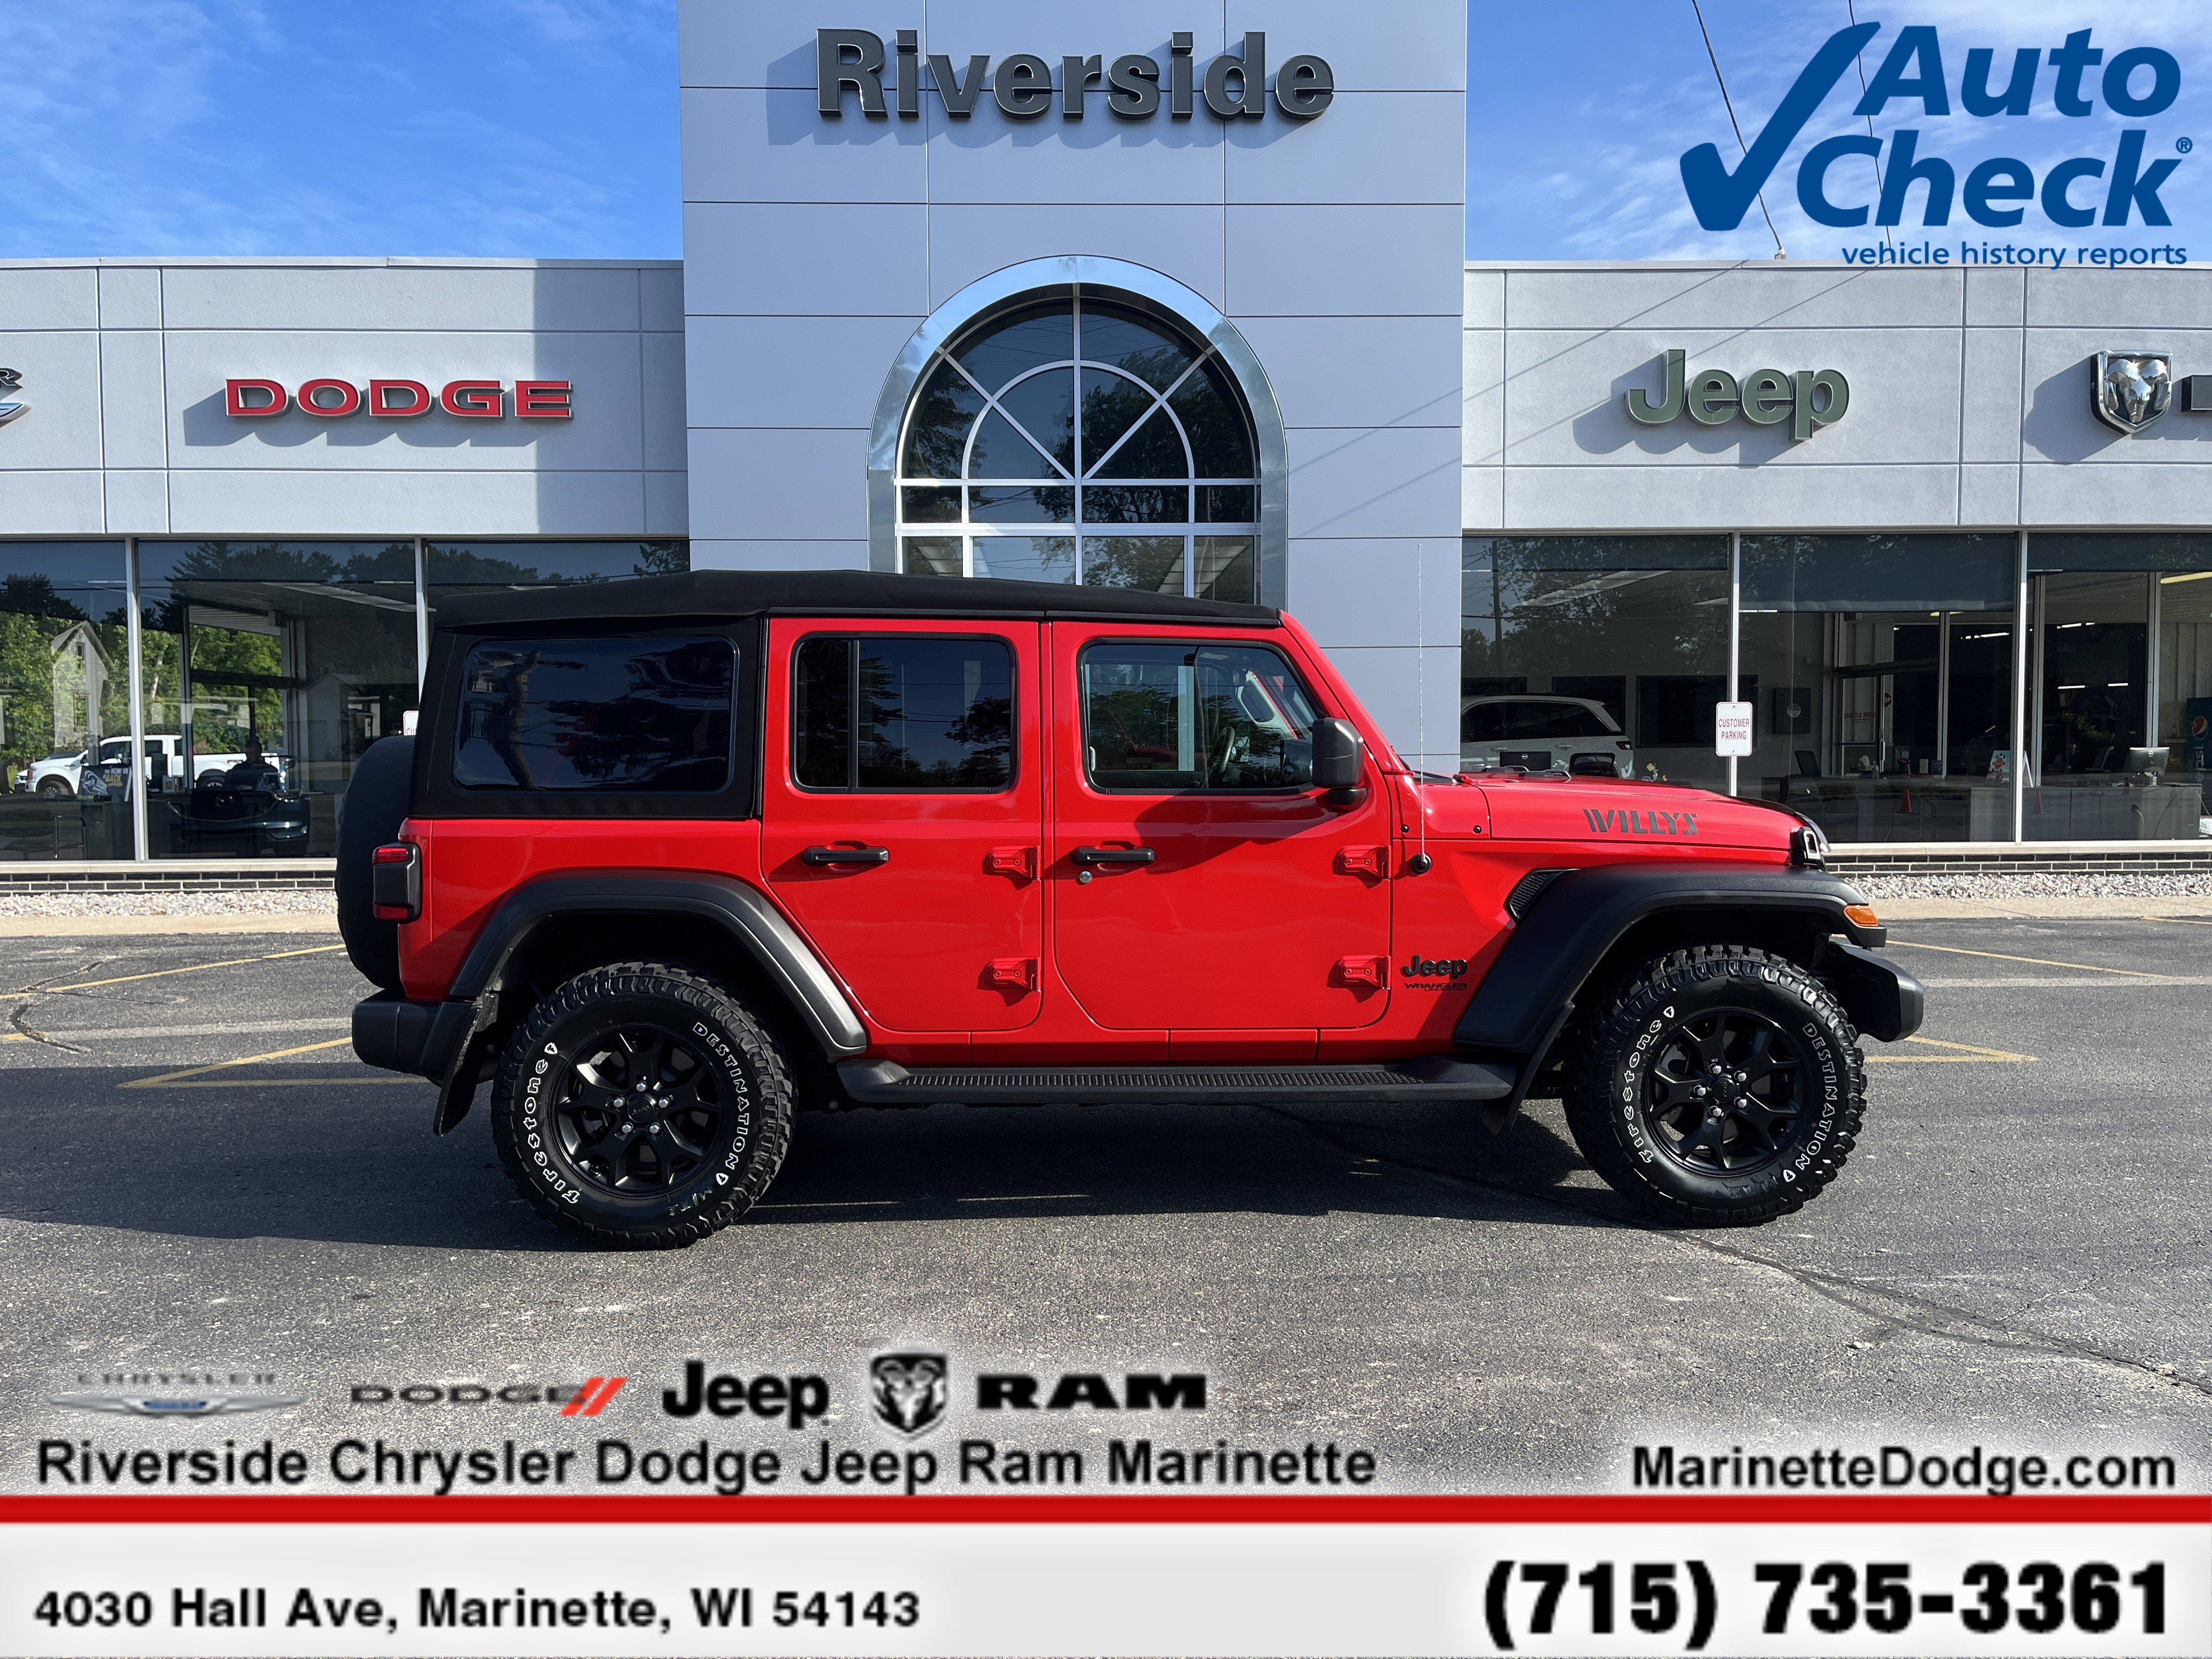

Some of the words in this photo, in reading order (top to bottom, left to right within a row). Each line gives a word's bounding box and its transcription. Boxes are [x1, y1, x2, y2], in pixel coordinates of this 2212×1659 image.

[816, 29, 1334, 120] Riverside
[225, 378, 574, 420] DODGE
[1624, 349, 1850, 442] Jeep
[1718, 718, 1750, 728] CUSTOMER
[1721, 730, 1747, 740] PARKING
[1583, 809, 1697, 836] WILLYS
[1403, 955, 1468, 979] Jeep
[523, 1058, 581, 1204] Firestone
[693, 1022, 749, 1170] DESTINATION
[1622, 1019, 1662, 1164] Firestone
[1795, 1022, 1838, 1170] DESTINATION
